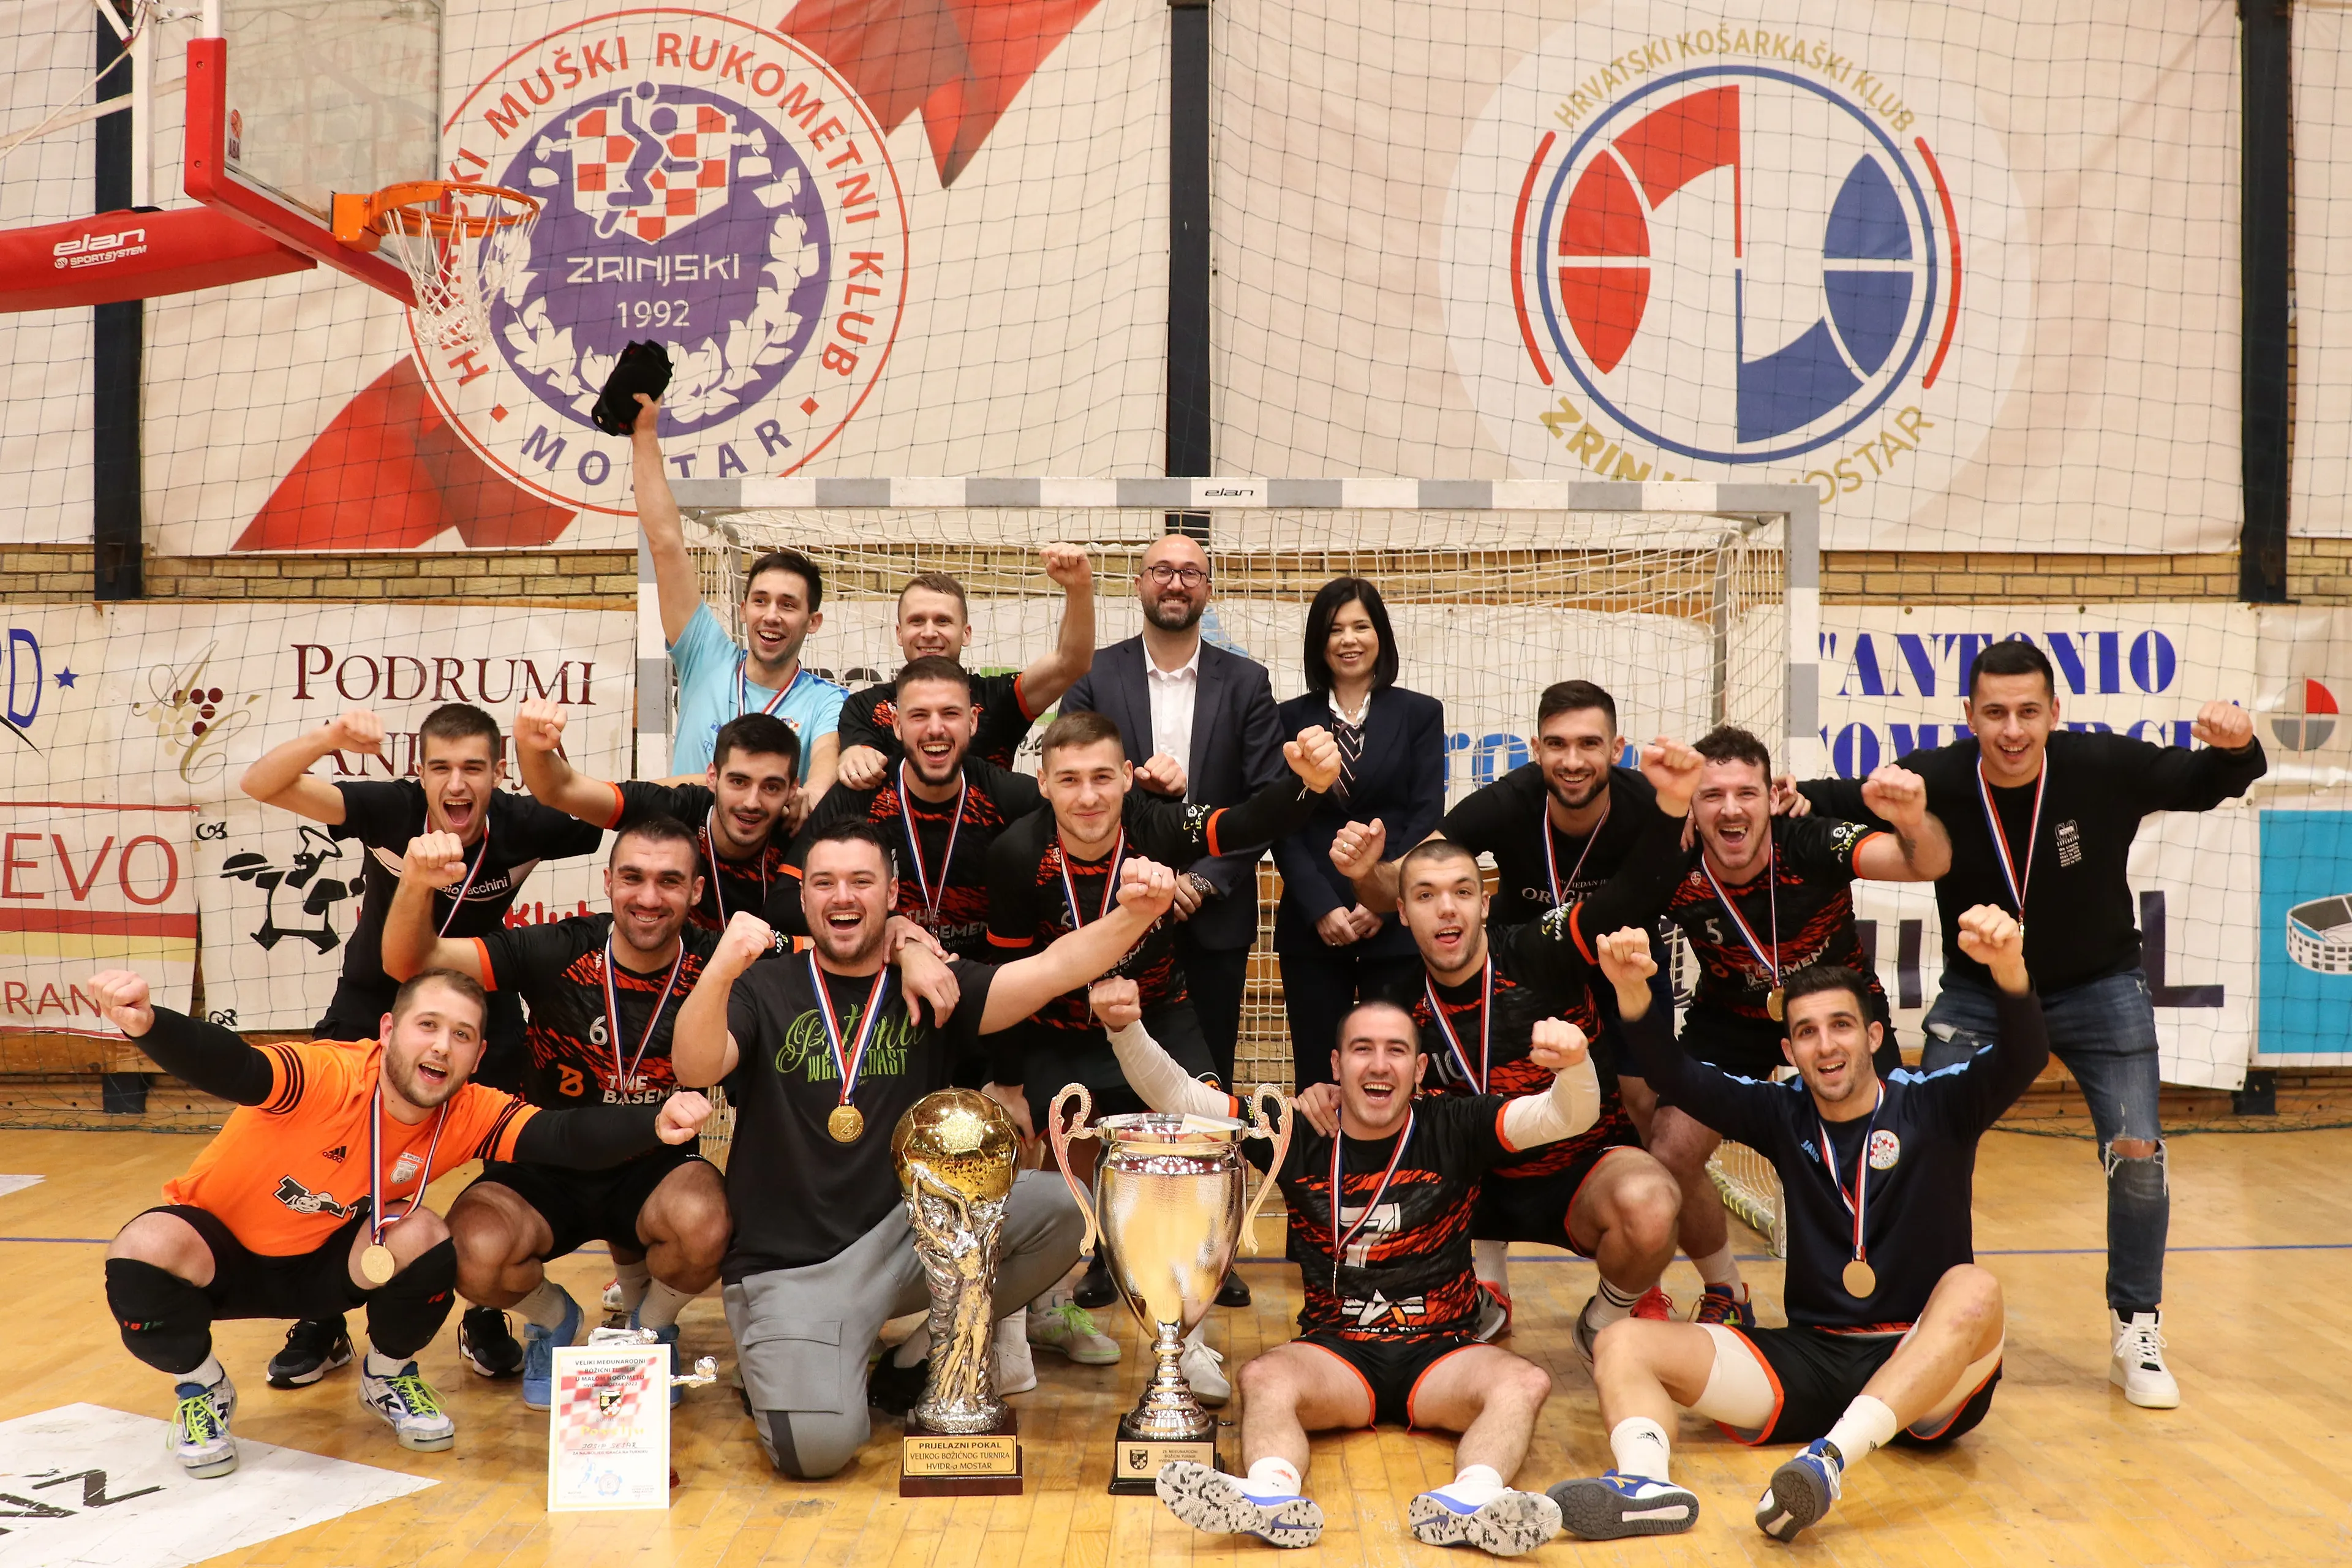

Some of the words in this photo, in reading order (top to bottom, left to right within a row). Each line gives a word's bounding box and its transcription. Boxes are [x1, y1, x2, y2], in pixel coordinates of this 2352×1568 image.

[1553, 37, 1673, 130] HRVATSKI
[1677, 20, 1856, 85] KOŠARKAŠKI
[1850, 72, 1917, 133] KLUB
[484, 36, 629, 140] MUŠKI
[656, 31, 881, 225] RUKOMETNI
[821, 251, 885, 378] KLUB
[53, 228, 146, 256] elan
[70, 245, 148, 266] SPORTSYSTEM
[616, 300, 690, 329] 1992
[521, 418, 793, 490] MOTAR
[1789, 405, 1936, 506] OSTAR
[1205, 488, 1254, 497] elan
[291, 644, 597, 705] PODRUMI
[1819, 630, 2176, 697] "ANTNIO
[2, 832, 178, 905] EVO
[458, 876, 508, 895] acchini
[943, 939, 976, 948] OUNGE
[1705, 918, 1723, 944] 5
[589, 1015, 608, 1046] 6
[608, 1075, 648, 1091] THE
[1340, 1202, 1401, 1268] 7
